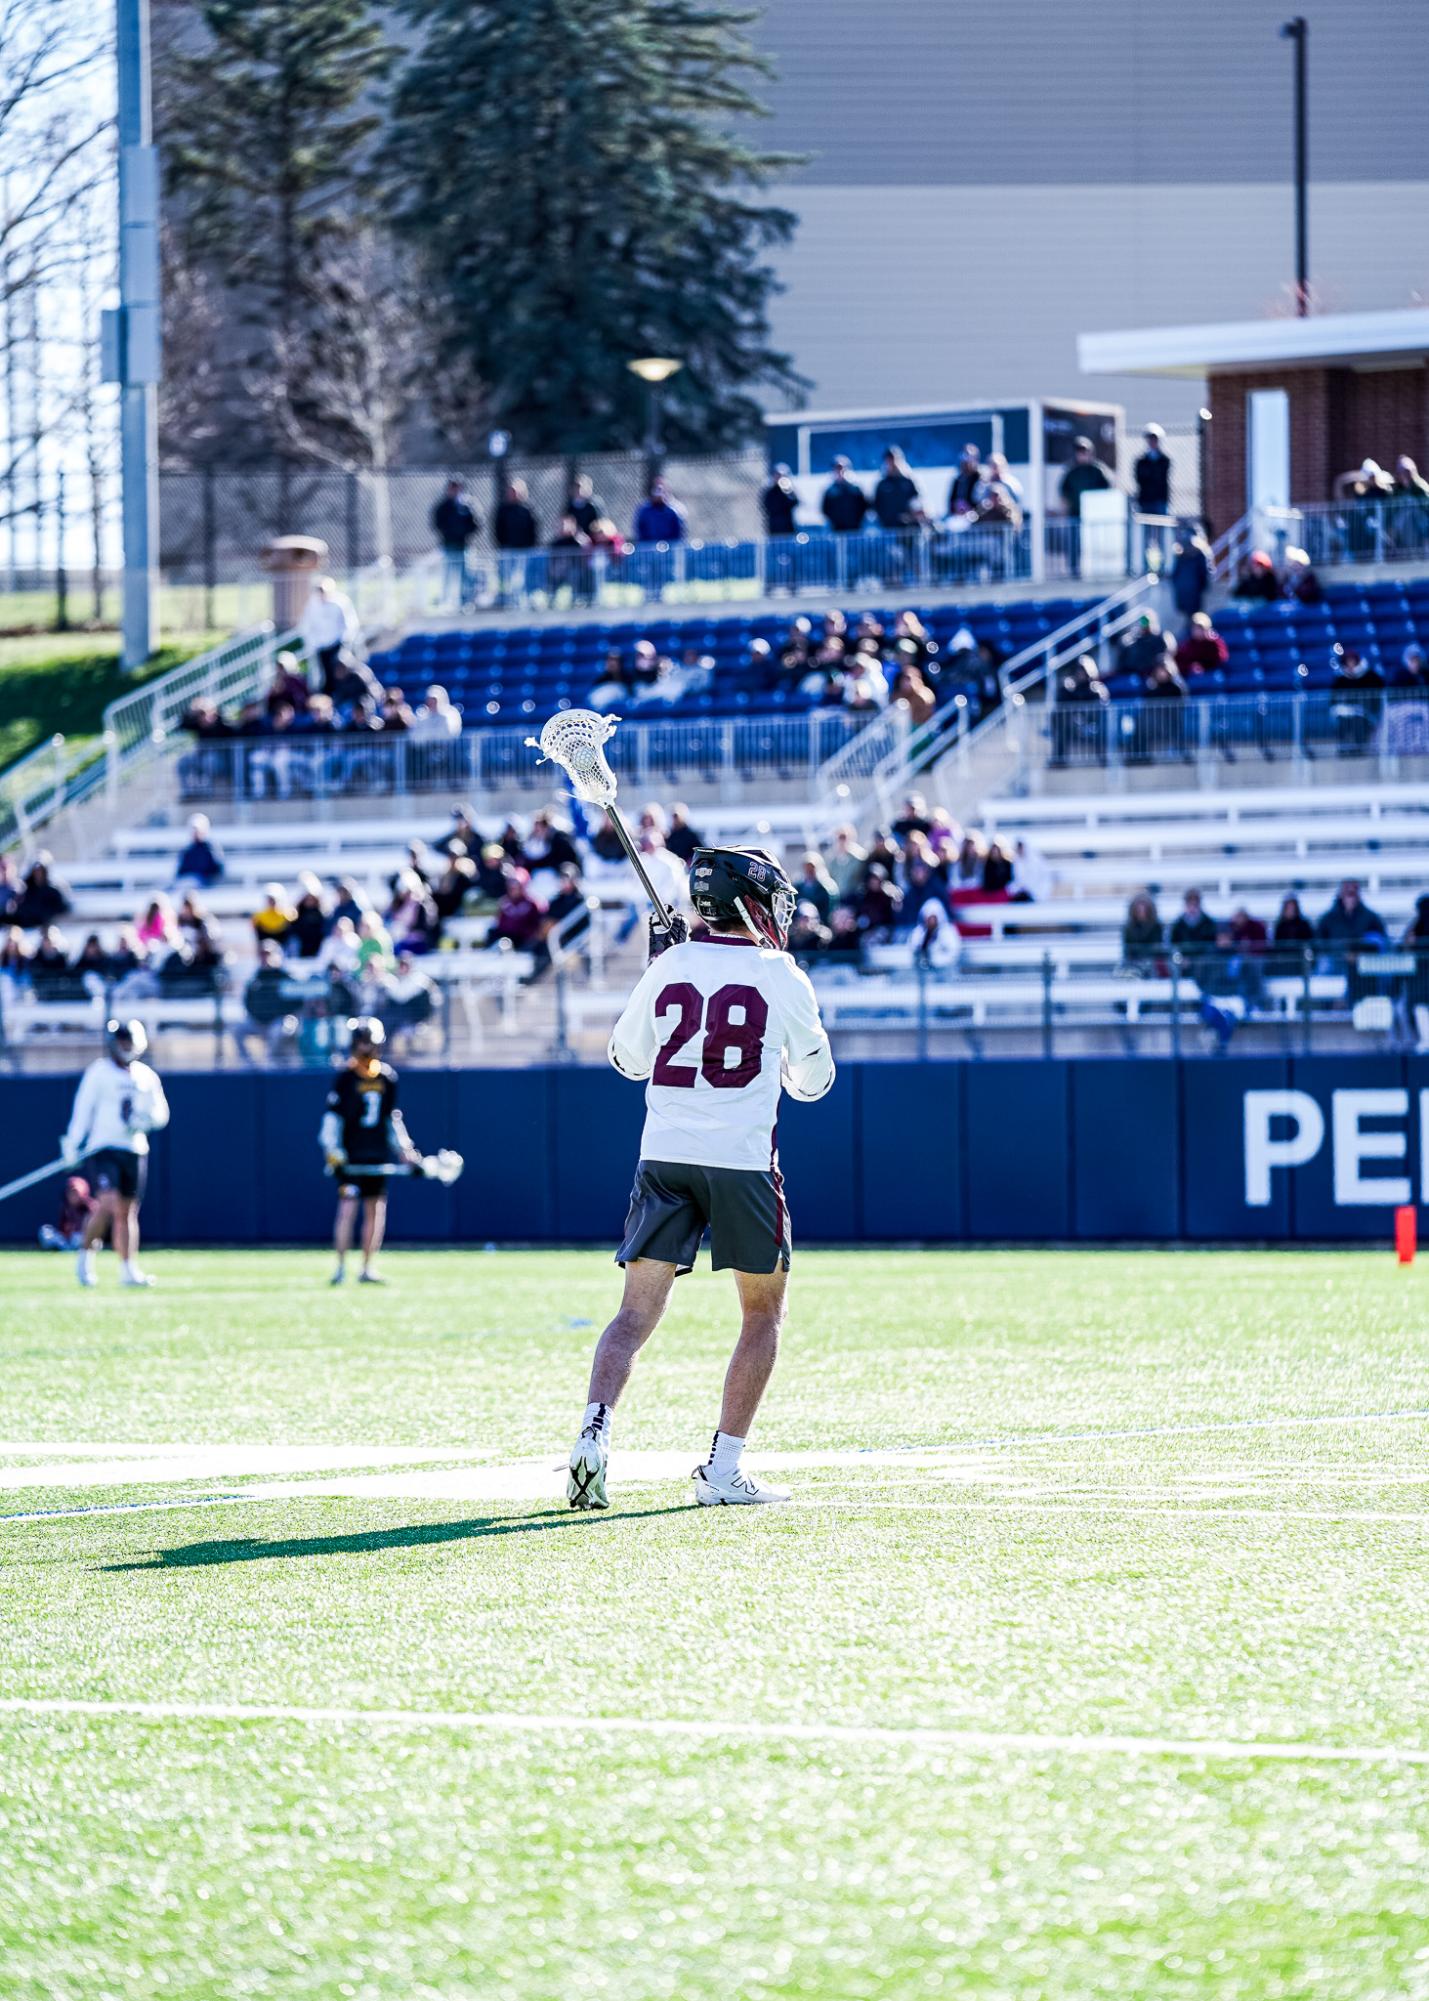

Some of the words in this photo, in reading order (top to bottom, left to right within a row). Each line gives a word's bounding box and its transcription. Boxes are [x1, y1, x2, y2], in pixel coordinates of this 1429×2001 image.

[747, 861, 767, 882] 28
[652, 982, 768, 1088] 28
[1243, 1087, 1429, 1207] PE
